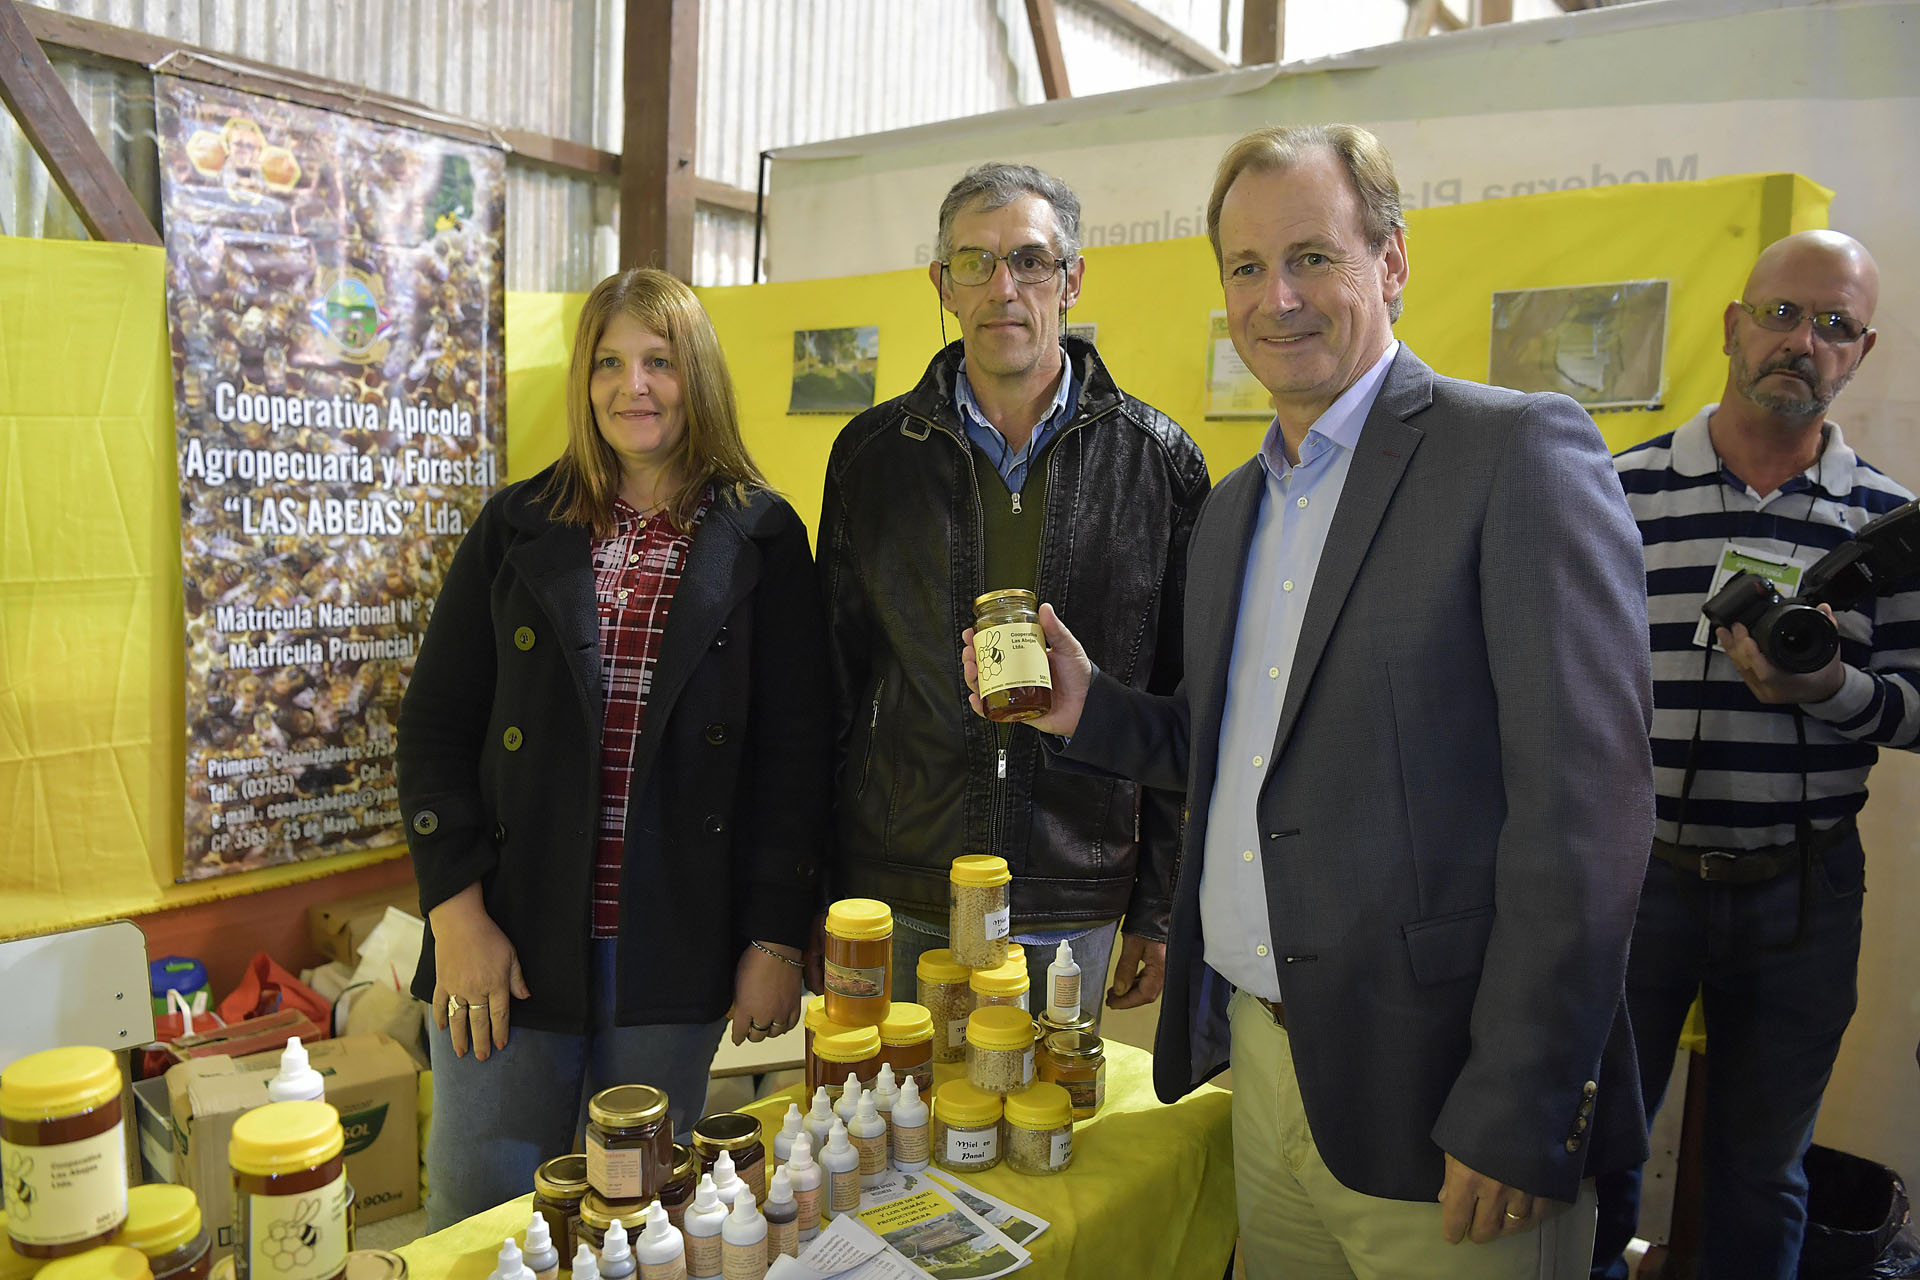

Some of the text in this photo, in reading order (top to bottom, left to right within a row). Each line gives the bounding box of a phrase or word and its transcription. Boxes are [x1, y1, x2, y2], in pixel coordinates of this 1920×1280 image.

[215, 381, 472, 440] Cooperativa Apícola
[186, 438, 496, 490] Agropecuaria y Forestal
[318, 600, 396, 628] Nacional
[329, 633, 413, 663] Provincial
[208, 756, 269, 778] Primeros
[241, 774, 295, 801] (03755)
[211, 832, 231, 852] CP
[283, 821, 301, 840] 25
[344, 1122, 370, 1140] SOL
[955, 1140, 978, 1150] Miel
[961, 1151, 985, 1161] Panal
[861, 1201, 904, 1217] PRODUCCIÓN
[915, 1191, 933, 1200] MIEL
[886, 1209, 900, 1217] LOS
[877, 1210, 919, 1226] PRODUCTOS
